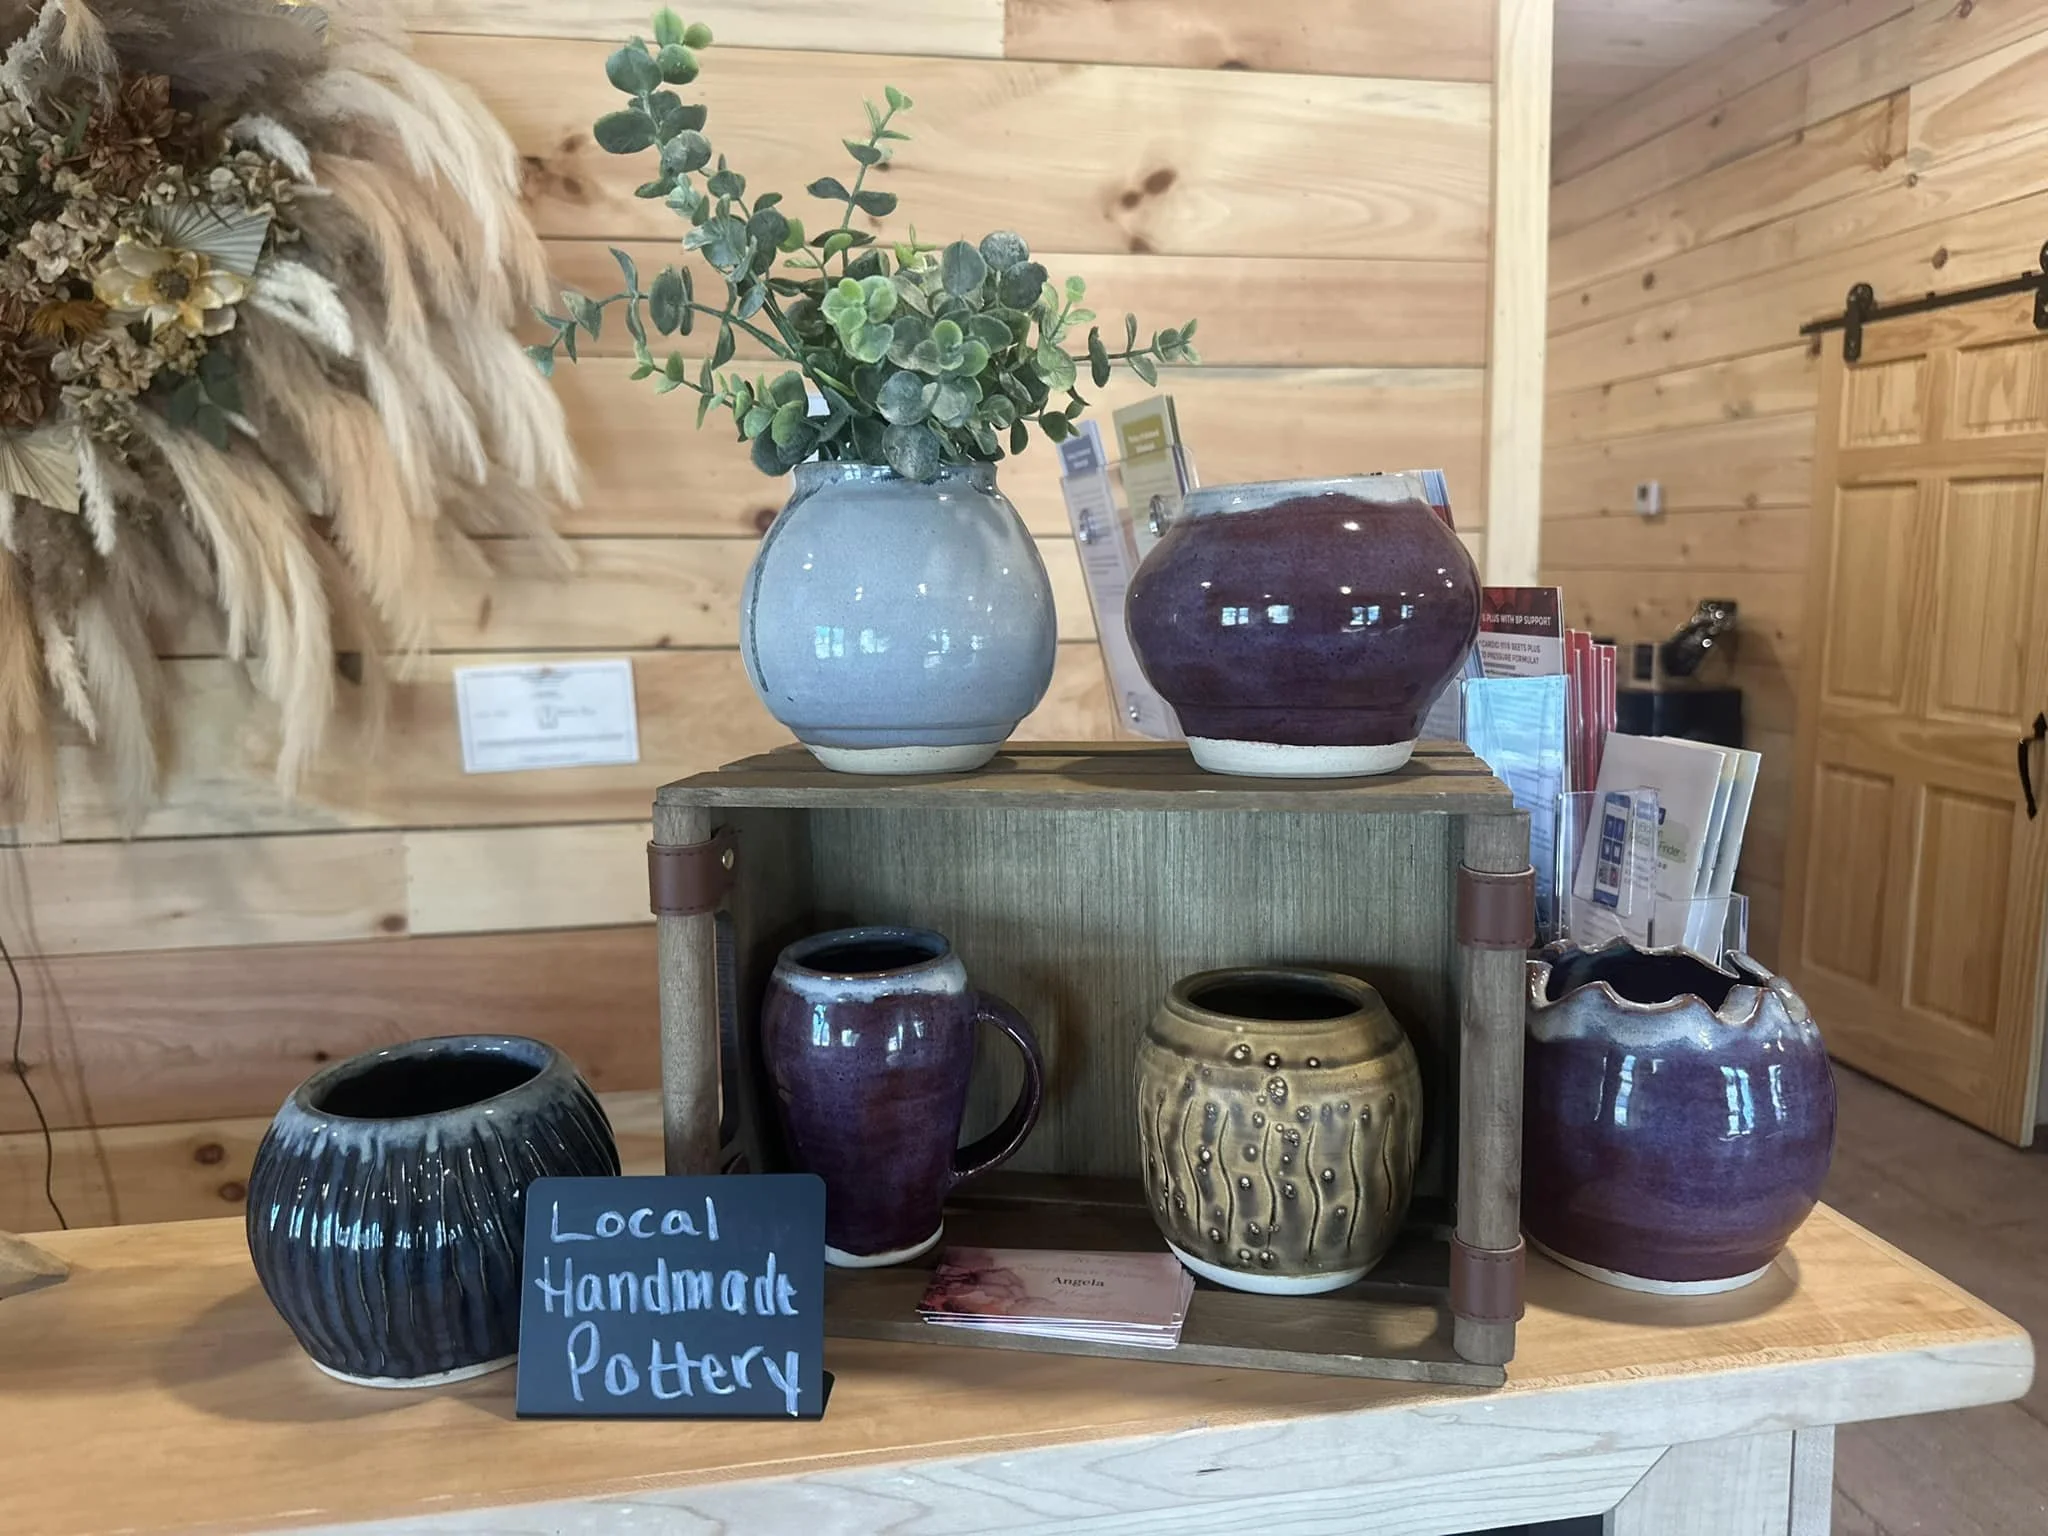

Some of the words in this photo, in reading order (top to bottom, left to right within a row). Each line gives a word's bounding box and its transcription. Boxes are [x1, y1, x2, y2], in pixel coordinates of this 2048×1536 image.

[1501, 614, 1514, 624] WITH
[1524, 615, 1552, 626] SUPPORT
[550, 1195, 720, 1243] Local
[534, 1251, 799, 1318] Handmade
[1052, 1276, 1106, 1289] Angela
[567, 1320, 803, 1417] Pottery
